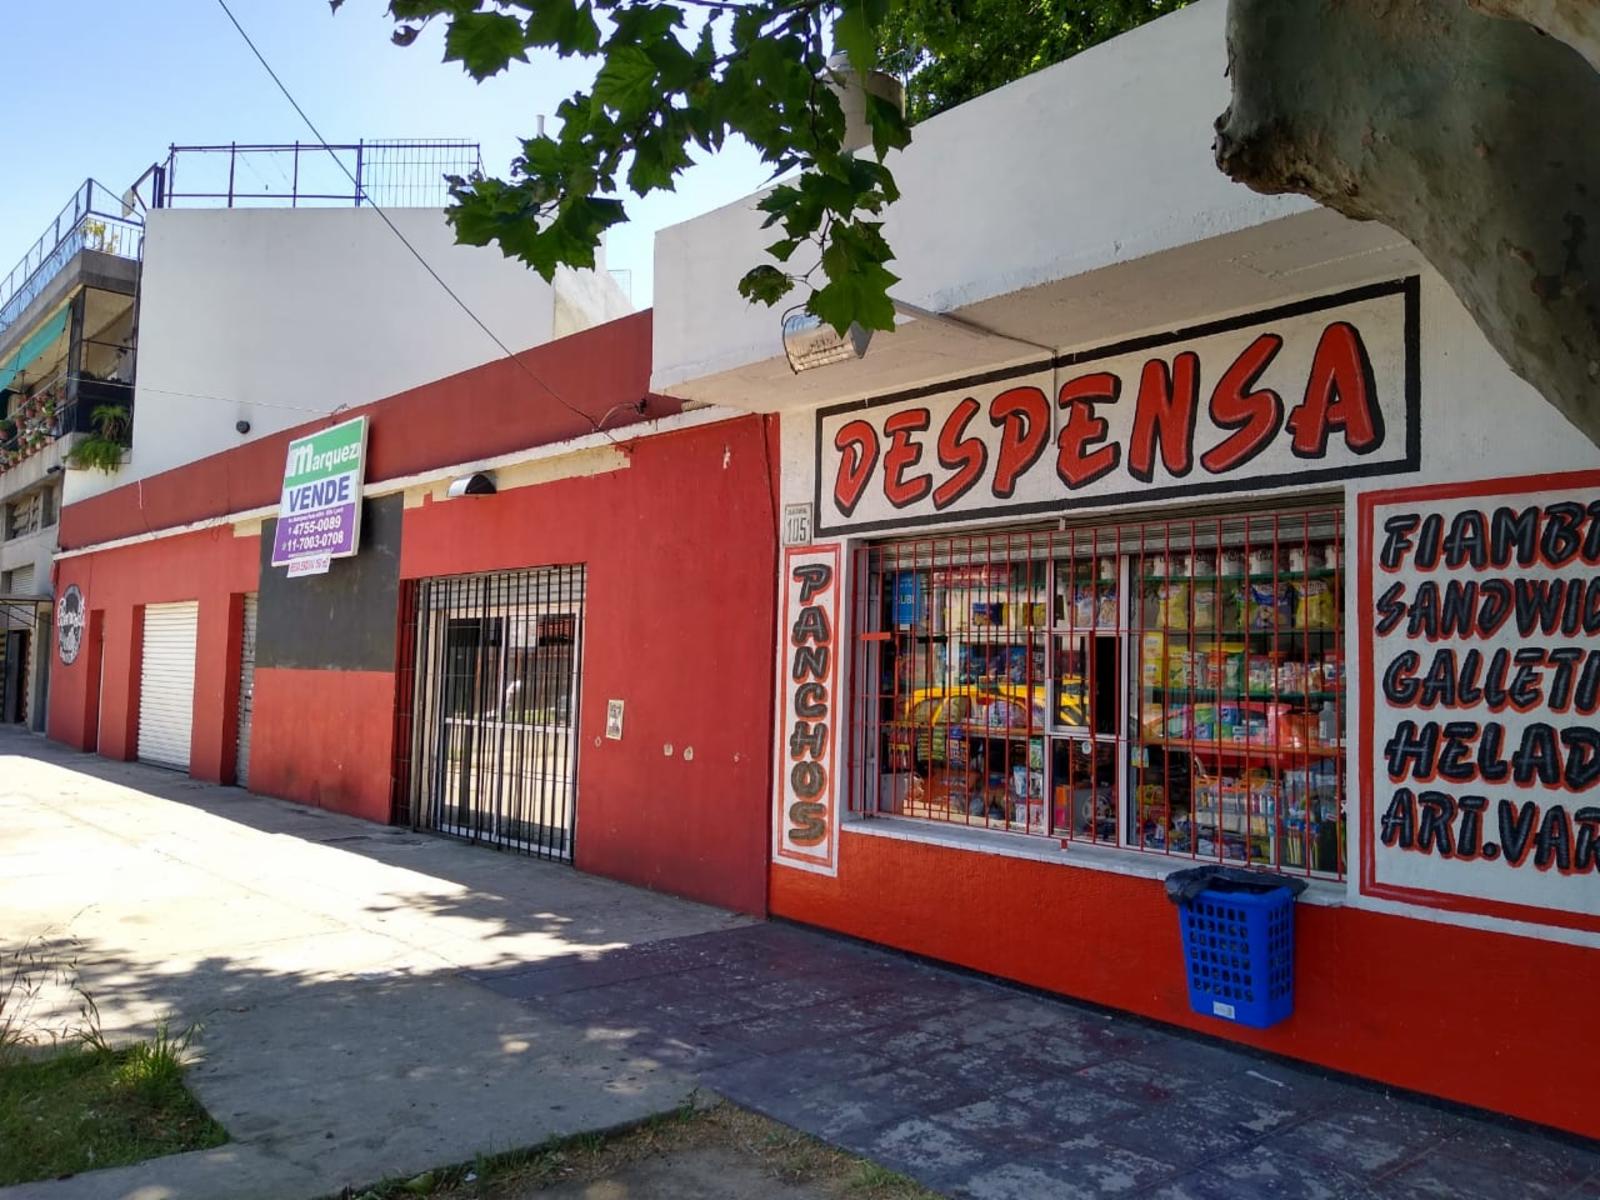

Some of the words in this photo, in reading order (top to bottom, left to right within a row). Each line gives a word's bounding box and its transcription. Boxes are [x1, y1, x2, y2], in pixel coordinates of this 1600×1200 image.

[833, 319, 1384, 519] DESPENSA
[289, 475, 351, 512] VENDE
[293, 515, 341, 536] 4755-0089
[788, 563, 833, 847] PANCHOS
[1384, 719, 1600, 792] HELAD
